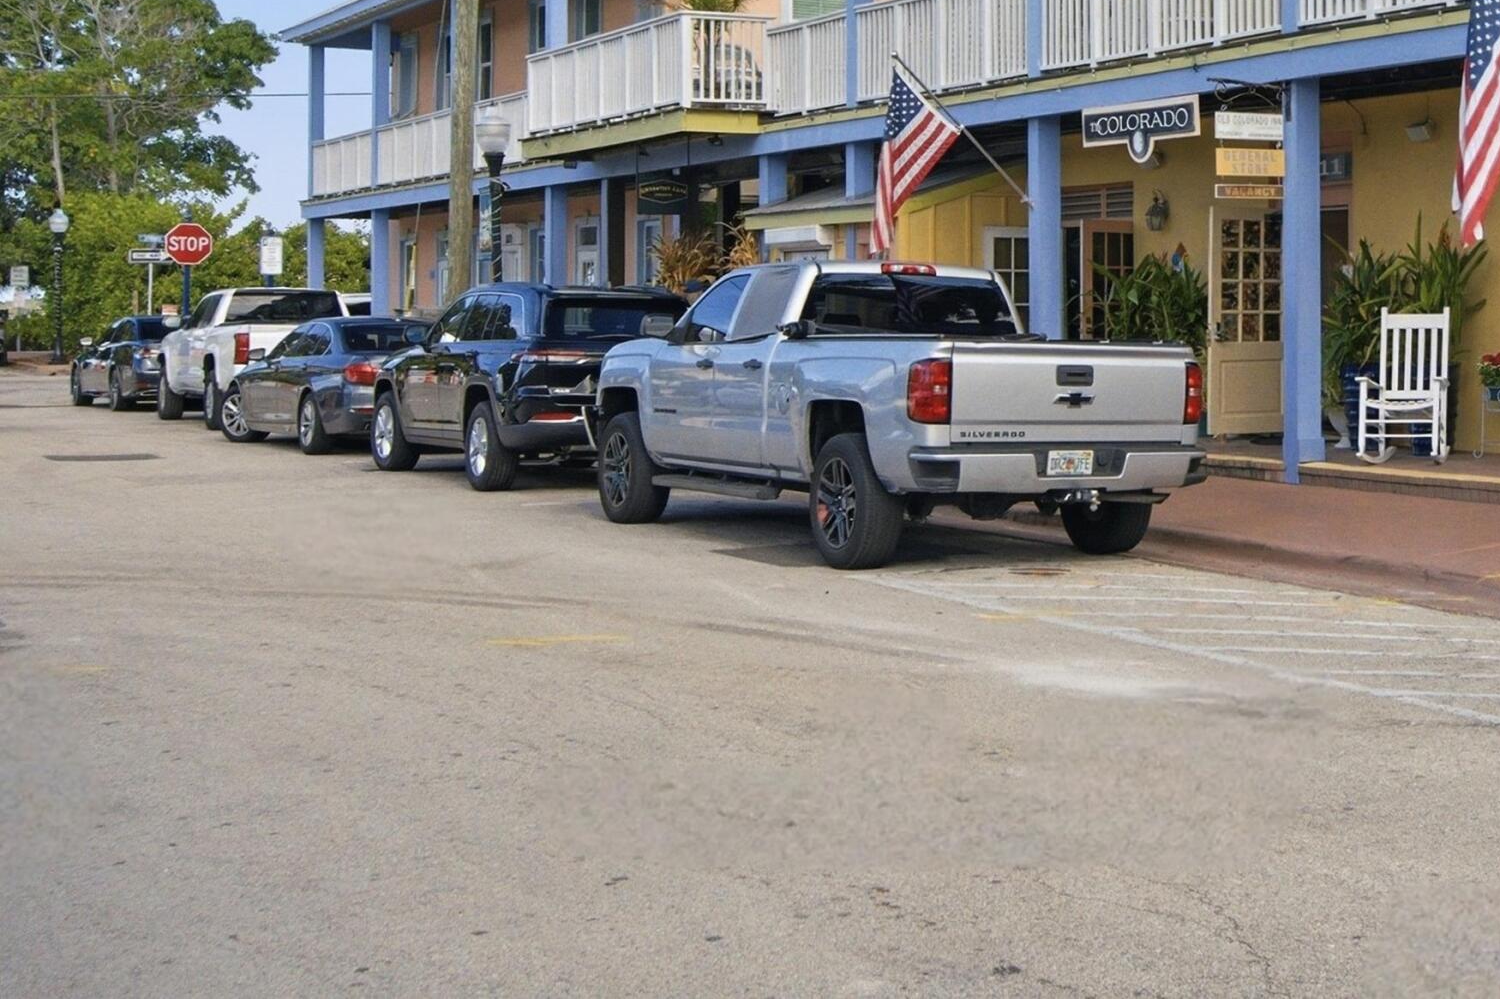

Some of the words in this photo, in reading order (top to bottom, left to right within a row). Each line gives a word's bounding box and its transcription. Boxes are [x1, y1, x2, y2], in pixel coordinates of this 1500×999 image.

[1096, 107, 1189, 136] COLORADO
[1223, 186, 1276, 197] VACANCY
[168, 236, 210, 252] STOP
[959, 431, 1026, 439] SILVERADO
